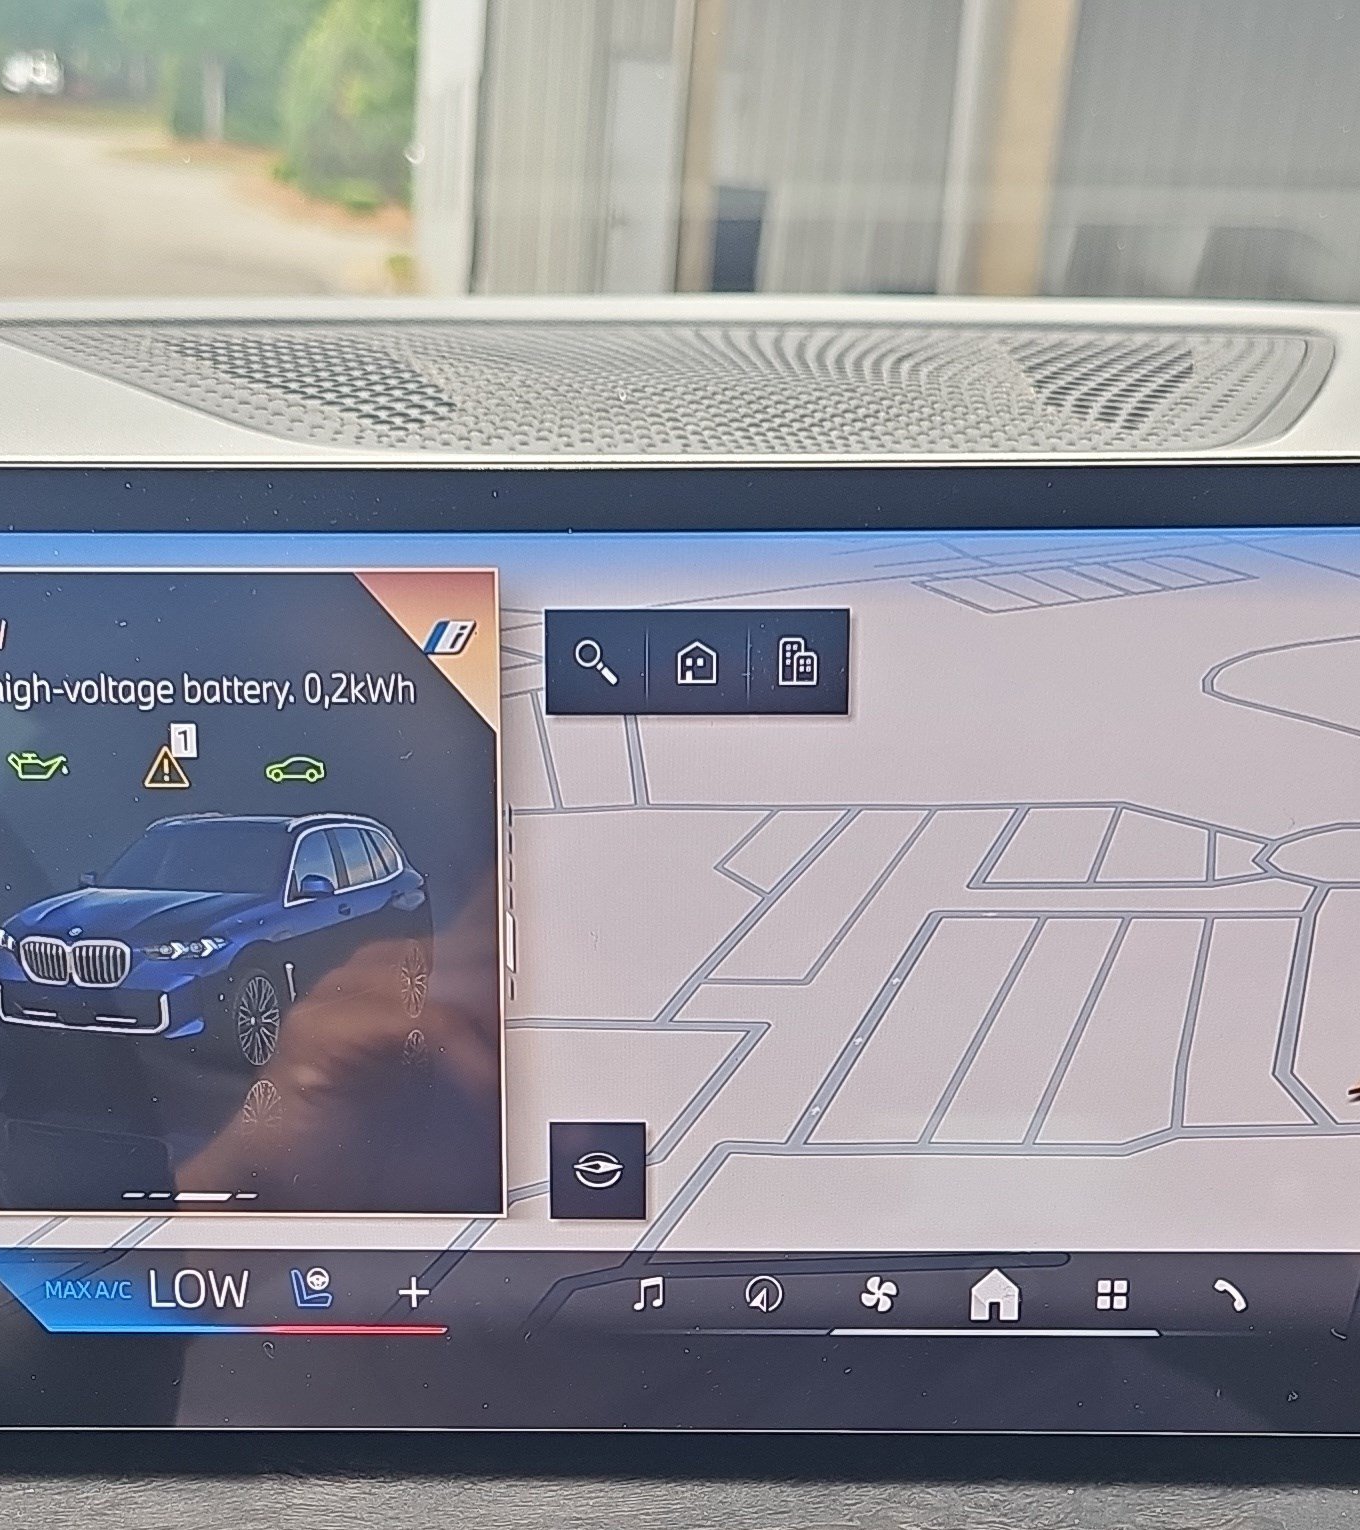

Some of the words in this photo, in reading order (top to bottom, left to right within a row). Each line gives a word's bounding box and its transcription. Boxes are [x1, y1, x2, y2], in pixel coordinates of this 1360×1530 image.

[183, 672, 295, 709] battery.
[304, 672, 416, 709] 0,2kWh
[45, 1280, 92, 1300] MAX
[97, 1280, 132, 1300] A/C
[149, 1269, 250, 1309] LOW
